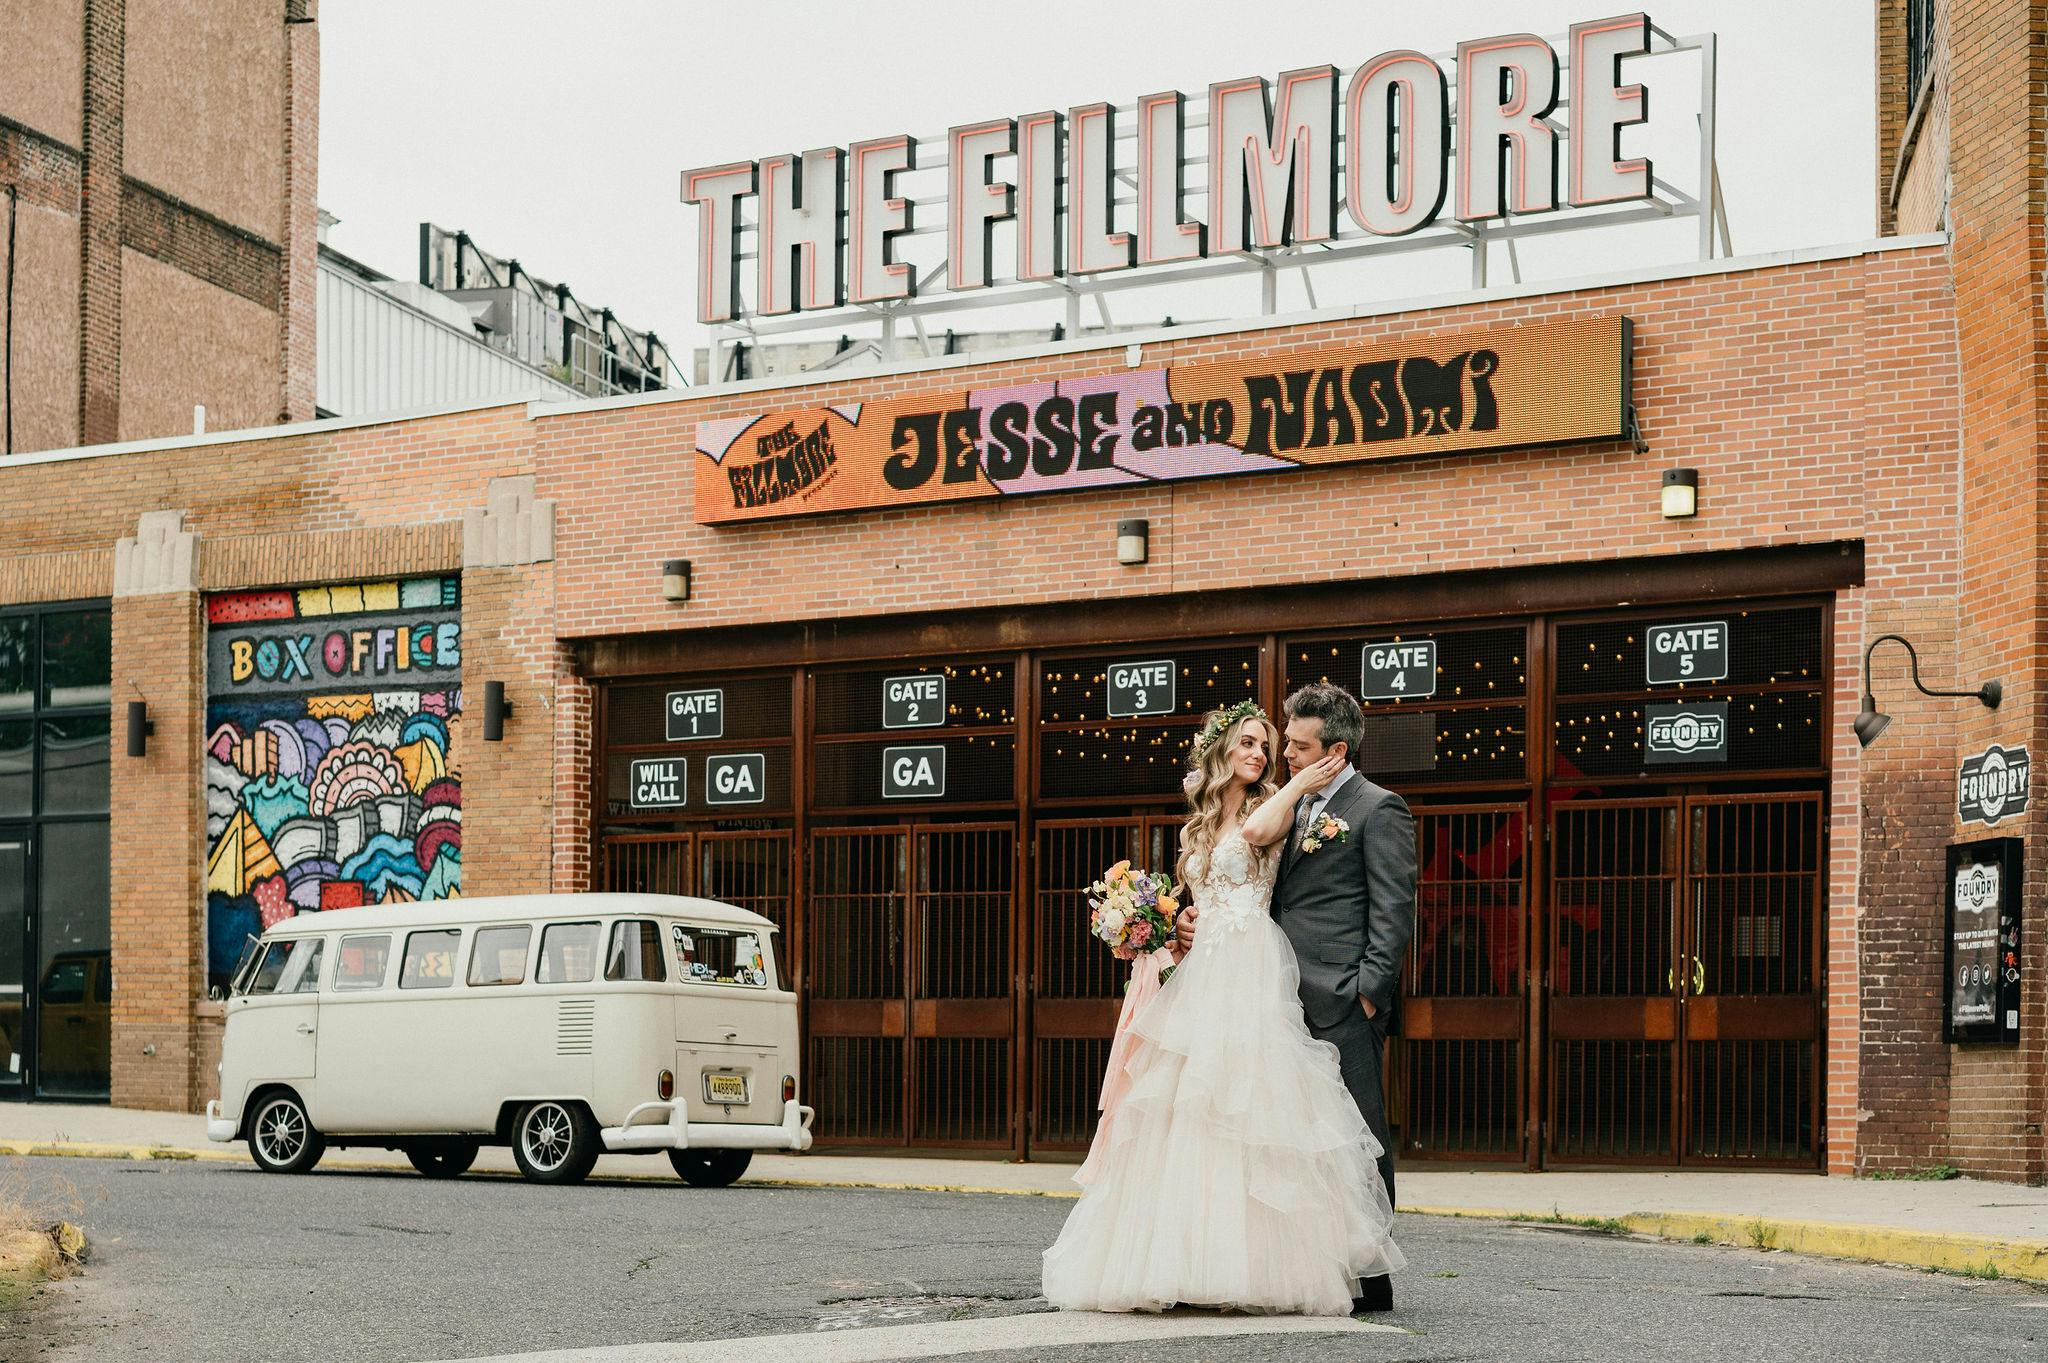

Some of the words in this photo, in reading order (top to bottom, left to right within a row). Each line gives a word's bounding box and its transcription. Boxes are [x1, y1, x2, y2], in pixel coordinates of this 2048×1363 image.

[680, 134, 917, 323] THE
[947, 12, 1652, 292] FILLMORE
[756, 420, 800, 458] THE
[884, 391, 1119, 490] JESSE
[1655, 628, 1719, 653] GATE
[230, 632, 314, 686] BOX
[323, 621, 461, 678] OFFICE
[1370, 646, 1428, 670] GATE
[1680, 654, 1694, 675] 5
[1114, 666, 1168, 689] GATE
[1390, 671, 1406, 692] 4
[889, 680, 939, 702] GATE
[1135, 689, 1147, 709] 3
[672, 694, 717, 716] GATE
[907, 703, 919, 722] 2
[690, 716, 698, 734] 1
[1652, 725, 1719, 741] FOUNDRY
[639, 764, 679, 783] WILL
[715, 764, 755, 794] GA
[892, 756, 935, 787] GA
[637, 784, 680, 803] CALL
[1961, 767, 2027, 802] FOUNDRY
[1958, 879, 1997, 897] FOUNDRY
